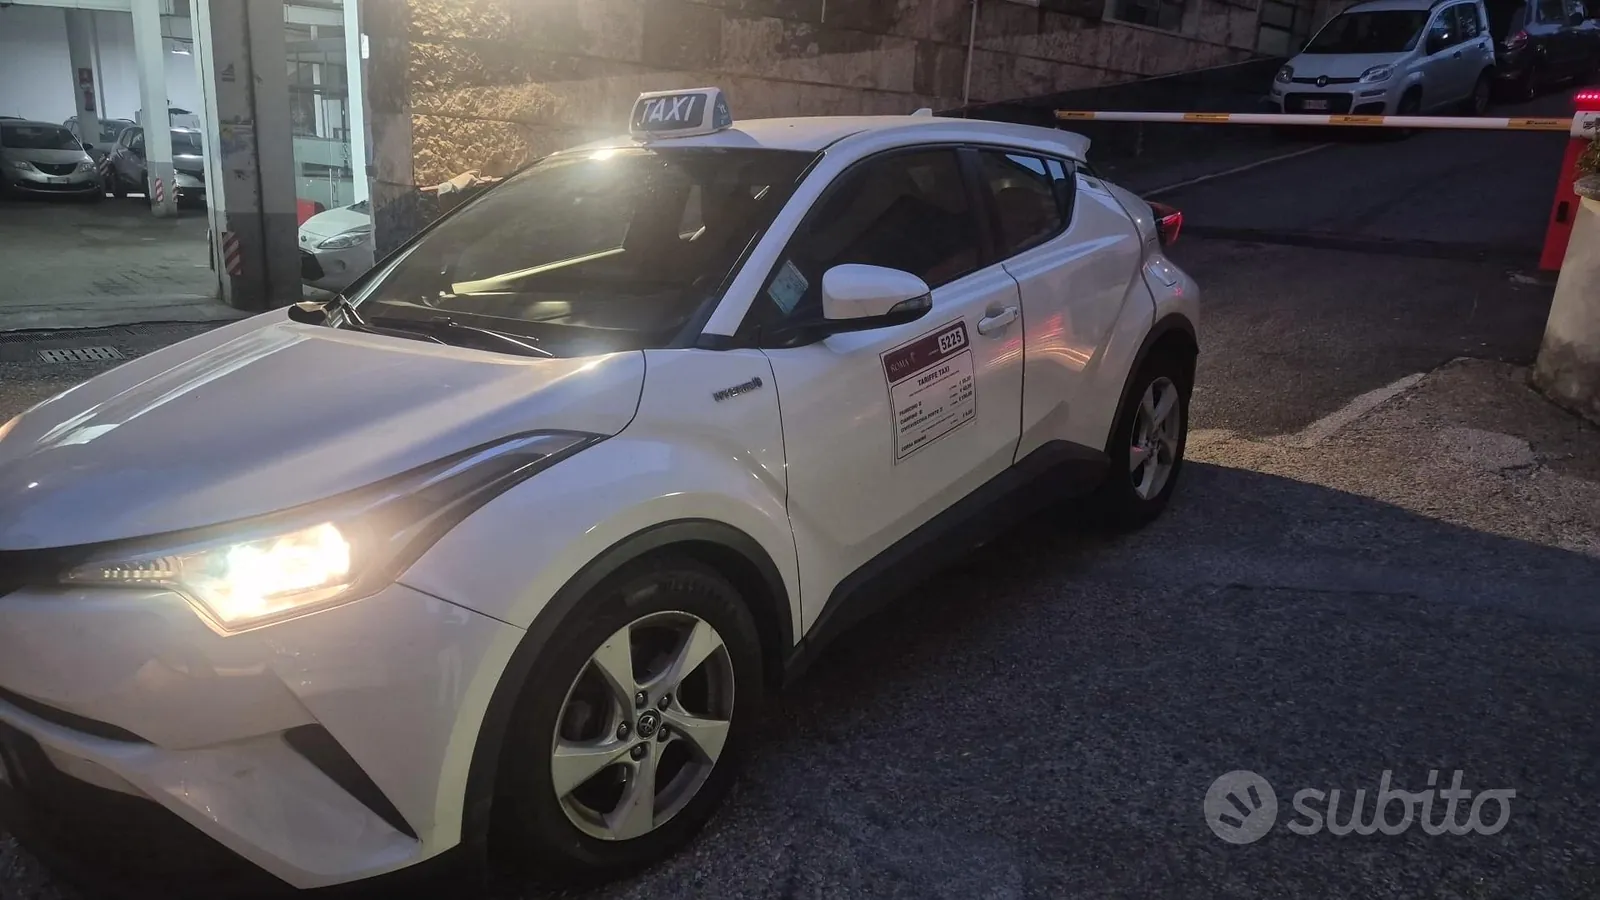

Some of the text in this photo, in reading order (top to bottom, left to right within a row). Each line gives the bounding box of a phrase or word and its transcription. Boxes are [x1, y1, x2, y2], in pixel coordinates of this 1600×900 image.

[641, 96, 696, 124] TAXI
[940, 330, 962, 350] 5225
[918, 370, 938, 386] TARIFFE
[938, 365, 950, 377] TAXI
